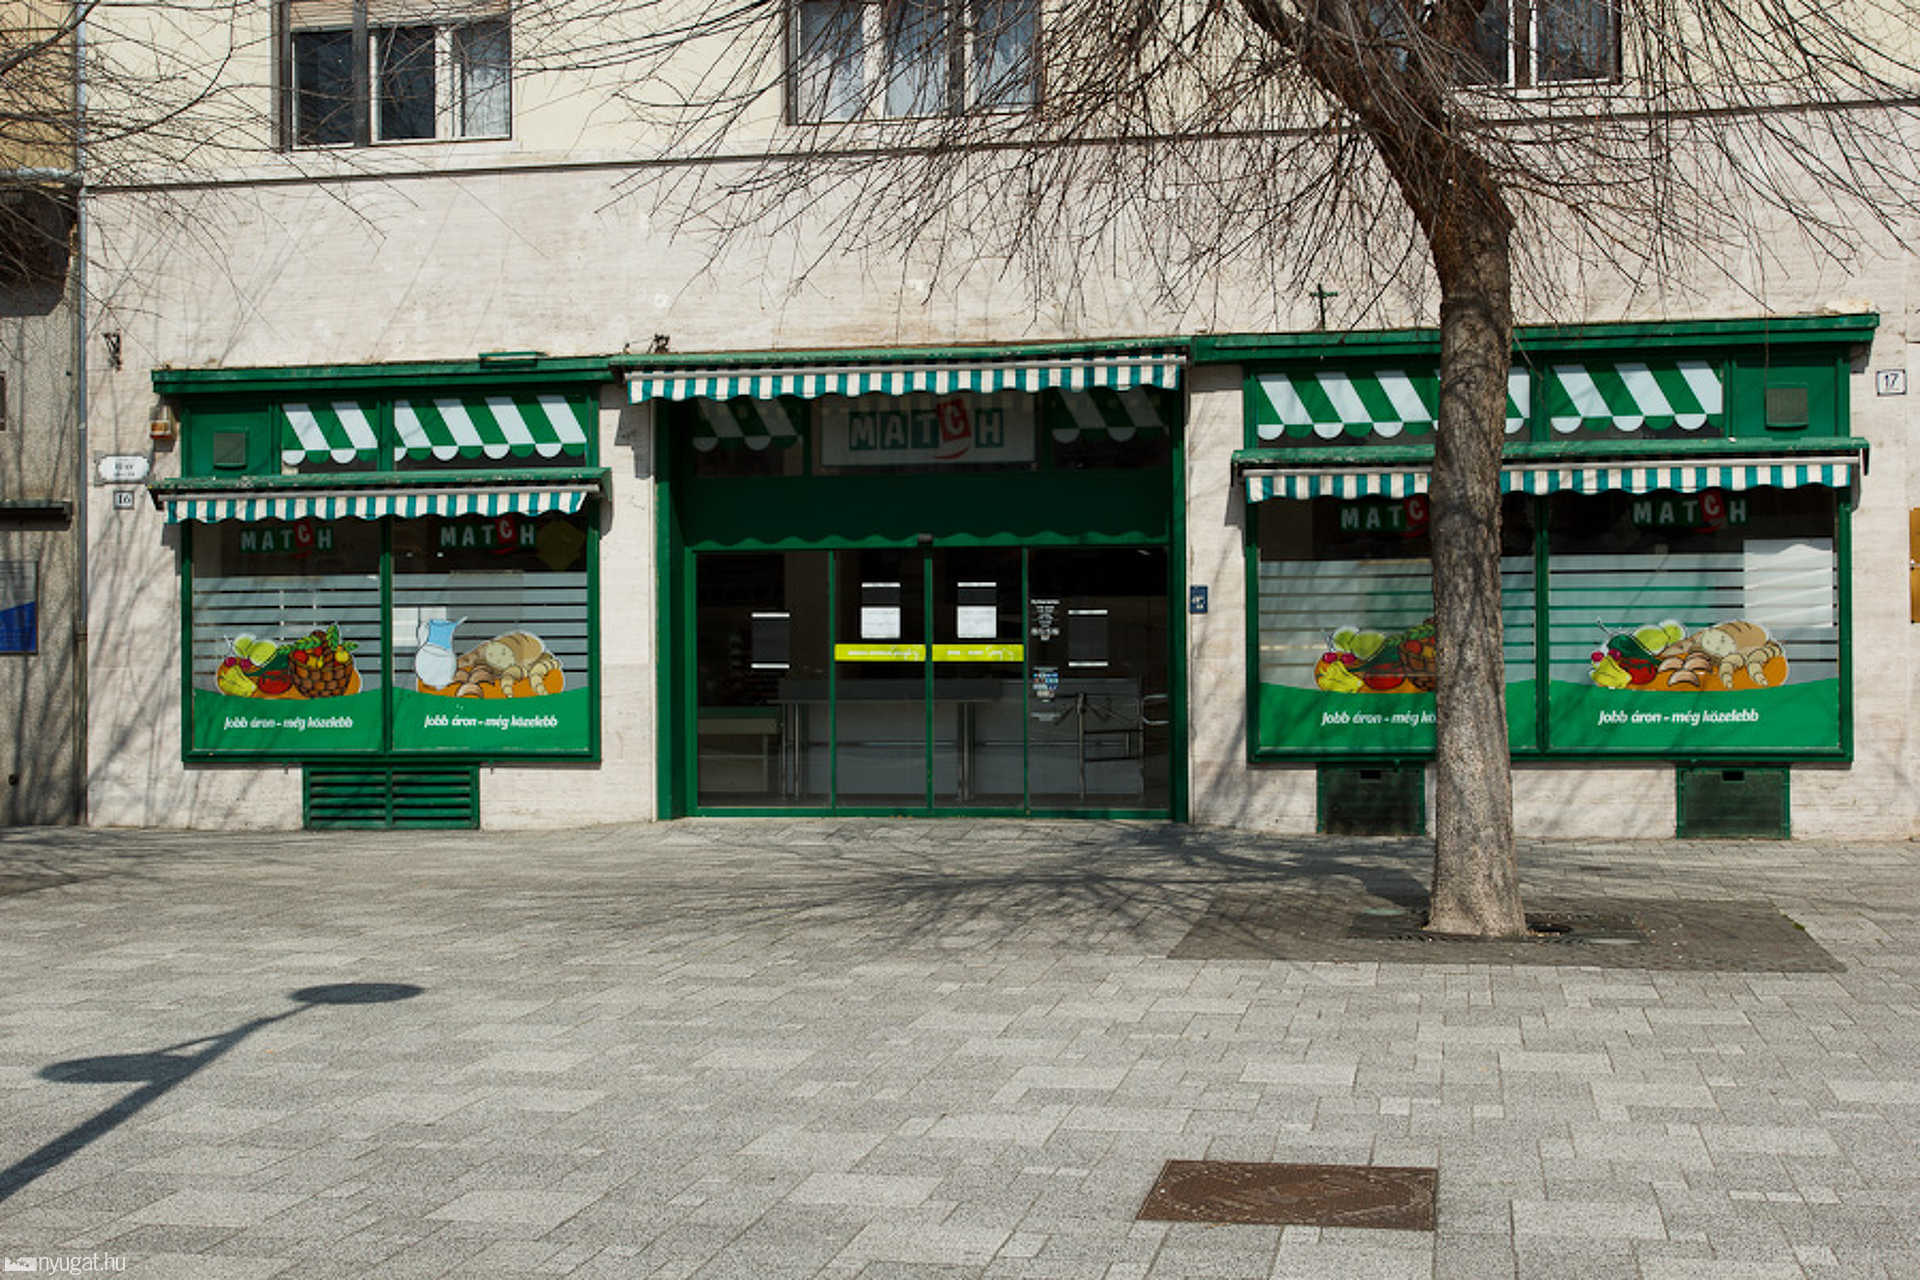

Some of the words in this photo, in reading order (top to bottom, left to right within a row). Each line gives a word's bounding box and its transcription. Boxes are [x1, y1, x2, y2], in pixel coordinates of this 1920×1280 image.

[1885, 372, 1899, 391] 17
[849, 400, 1003, 449] MATCH
[118, 494, 131, 504] 16
[1341, 500, 1425, 529] MATC
[1633, 494, 1746, 524] MATCH
[240, 522, 332, 550] MATCH
[441, 519, 535, 548] MATCH
[223, 716, 248, 730] Jobb
[250, 716, 276, 729] áron
[283, 716, 305, 732] még
[424, 714, 449, 729] Jobb
[451, 714, 477, 726] áron
[484, 714, 509, 730] még
[1320, 711, 1350, 726] Jobb
[1352, 710, 1382, 724] áron
[1391, 710, 1419, 727] még
[1598, 709, 1628, 726] Jobb
[1631, 709, 1662, 723] áron
[1672, 710, 1701, 727] még
[1702, 708, 1759, 723] közelebb
